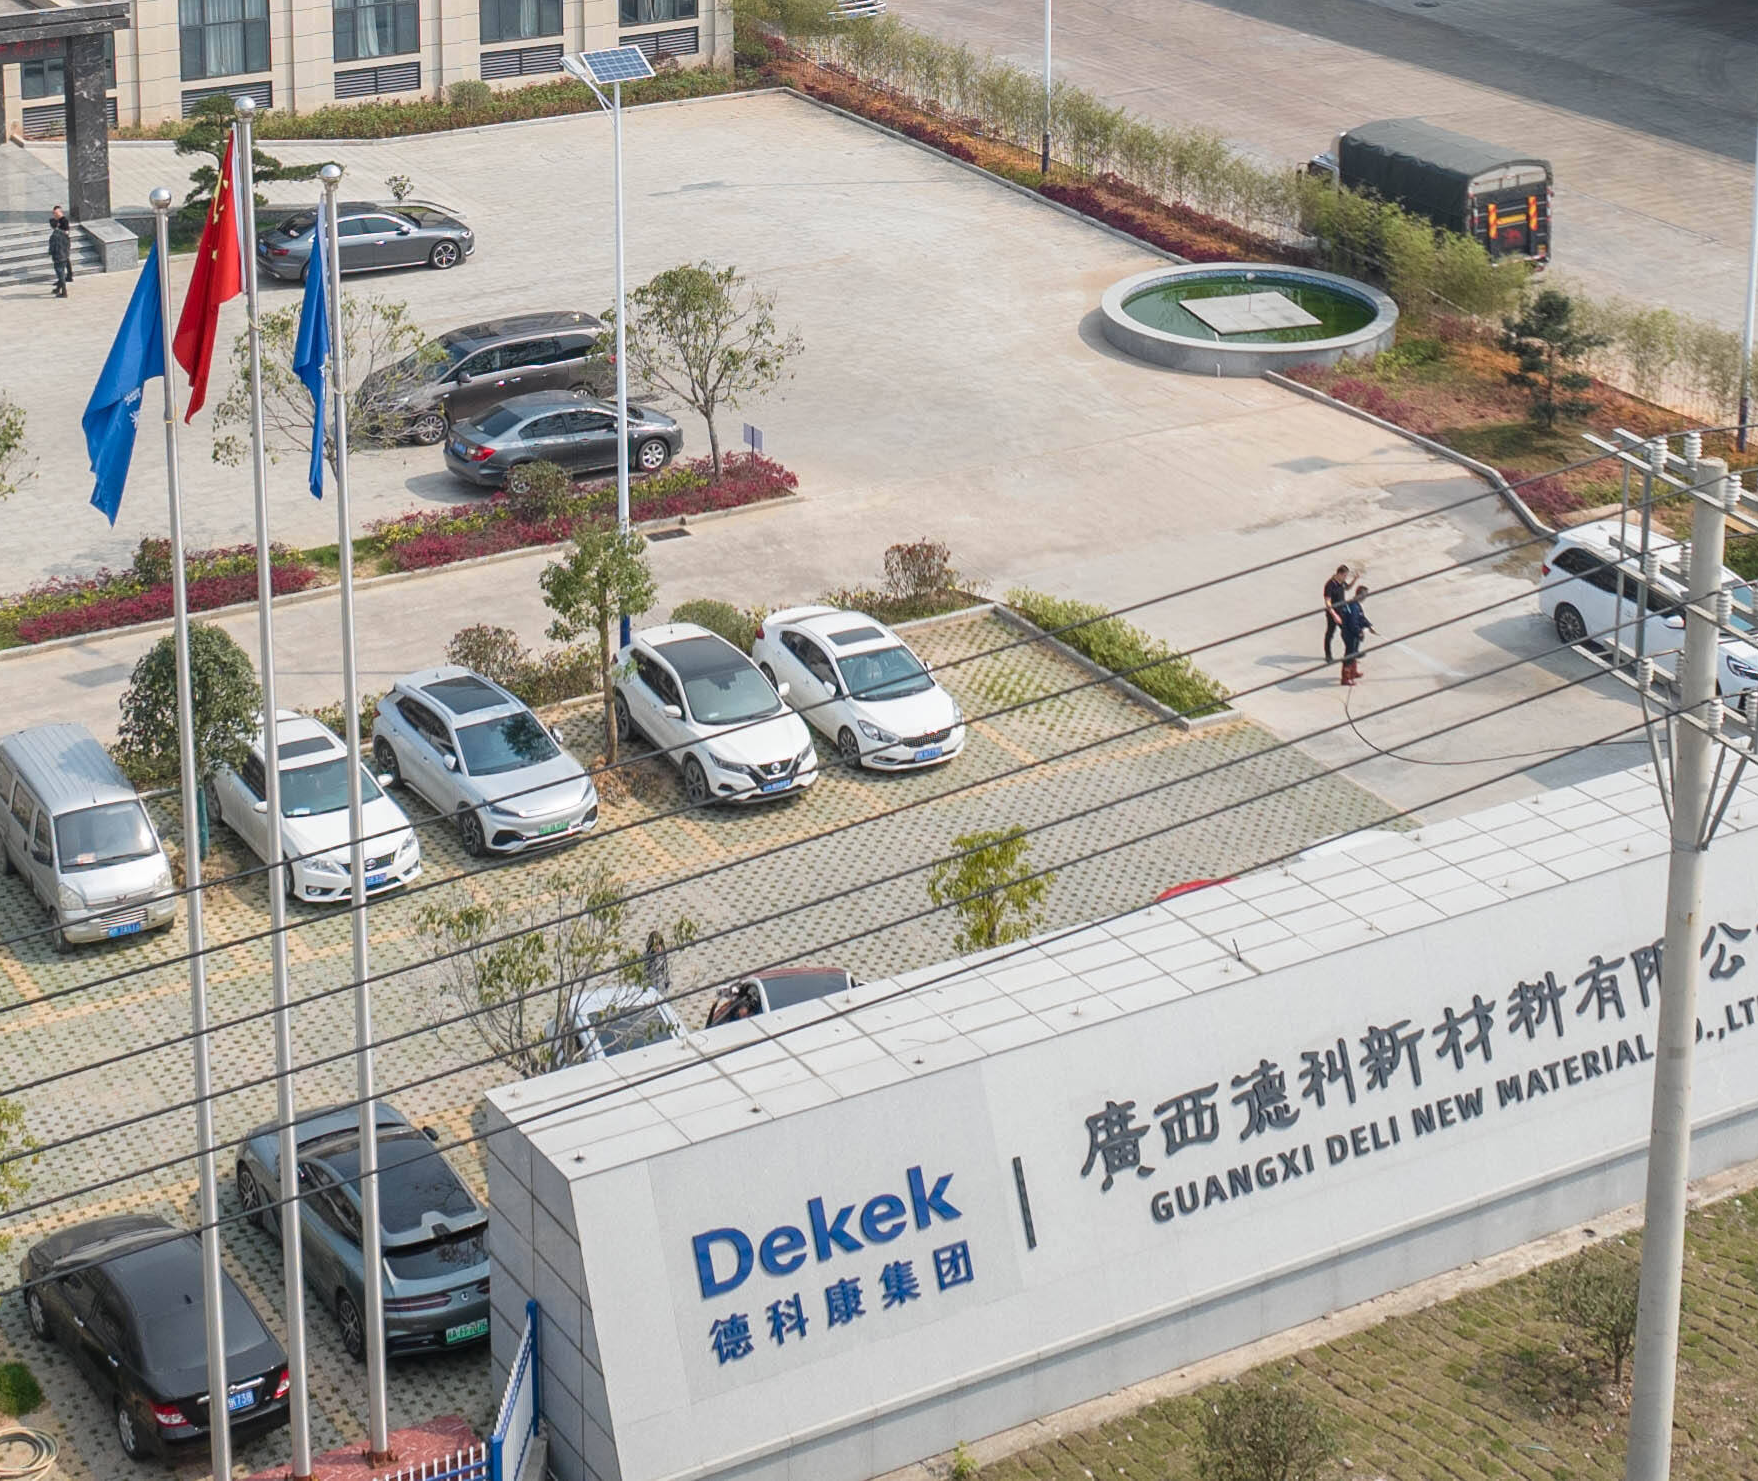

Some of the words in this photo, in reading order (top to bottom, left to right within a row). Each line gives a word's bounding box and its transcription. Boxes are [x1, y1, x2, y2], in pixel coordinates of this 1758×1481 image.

[1151, 1144, 1315, 1223] GUANGXI
[1326, 1115, 1401, 1166] DELI
[1411, 1088, 1484, 1137] NEW
[1496, 1034, 1654, 1108] MATERIAL
[691, 1165, 963, 1301] Dekek
[709, 1239, 975, 1366] 德科康集团
